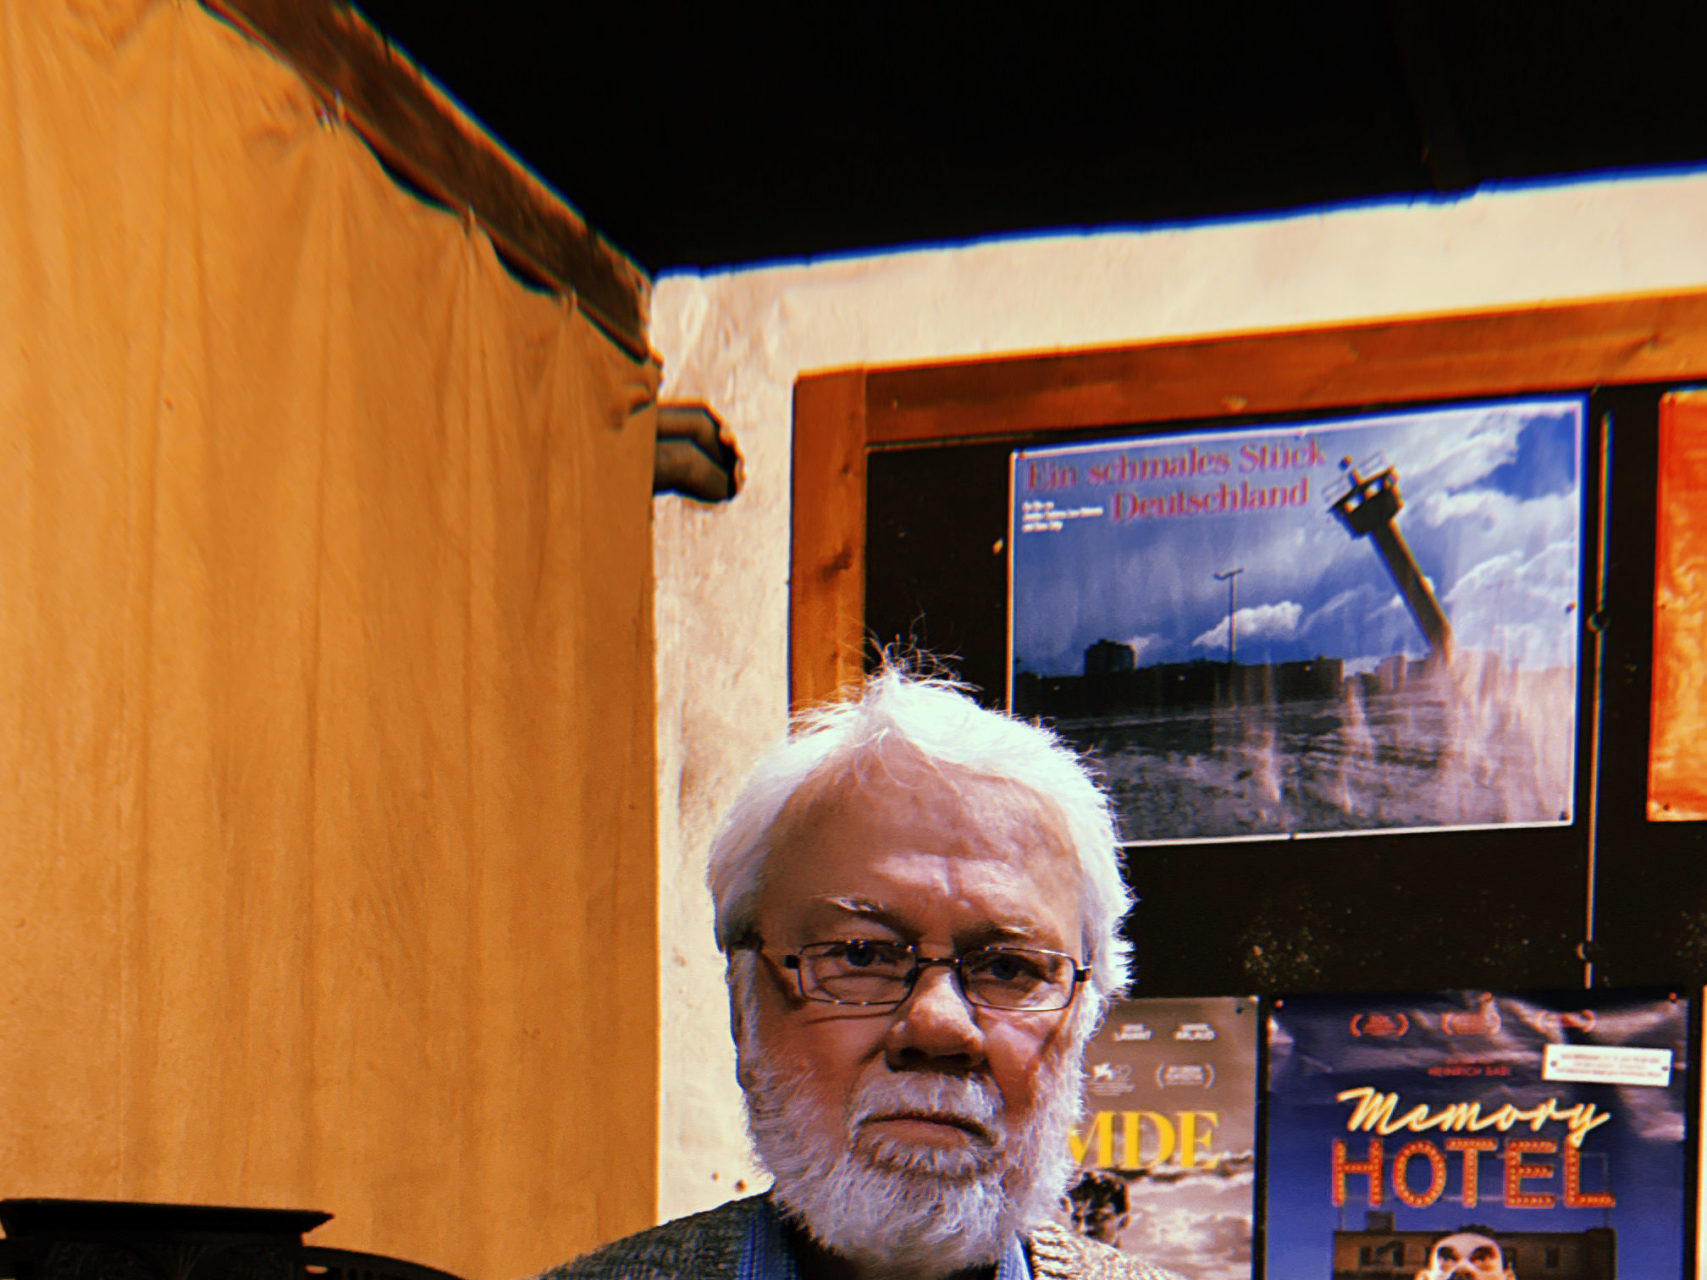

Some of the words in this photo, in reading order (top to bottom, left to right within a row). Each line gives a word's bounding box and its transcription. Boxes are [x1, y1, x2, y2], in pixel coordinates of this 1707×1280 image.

[1026, 460, 1077, 491] Ein
[1088, 446, 1231, 482] schmales
[1240, 437, 1326, 471] Stück
[1111, 477, 1309, 520] Deutschland
[1337, 1087, 1611, 1148] Memory
[1331, 1138, 1616, 1209] HOTEL
